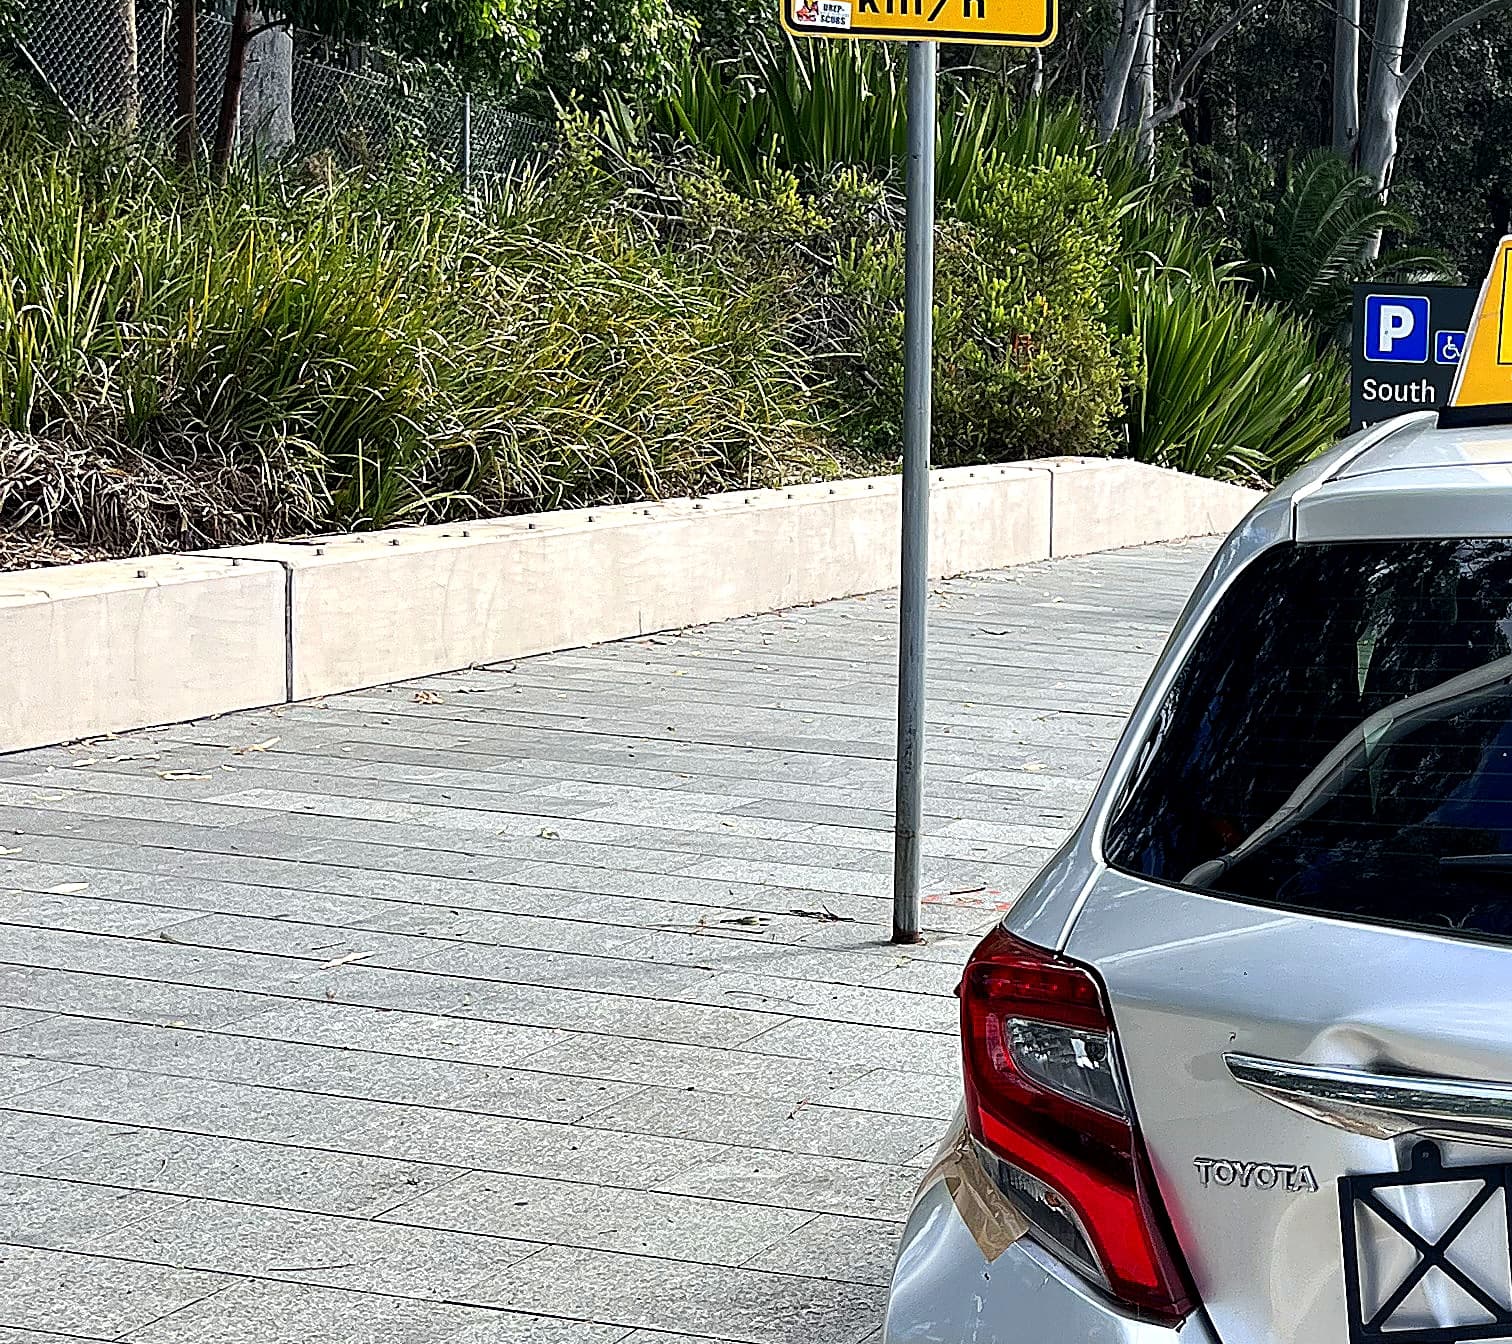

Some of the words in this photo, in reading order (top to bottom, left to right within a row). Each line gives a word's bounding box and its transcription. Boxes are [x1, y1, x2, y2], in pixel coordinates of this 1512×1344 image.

[1379, 305, 1415, 352] P
[1362, 378, 1435, 403] South
[1193, 1157, 1318, 1192] TOYOTA
